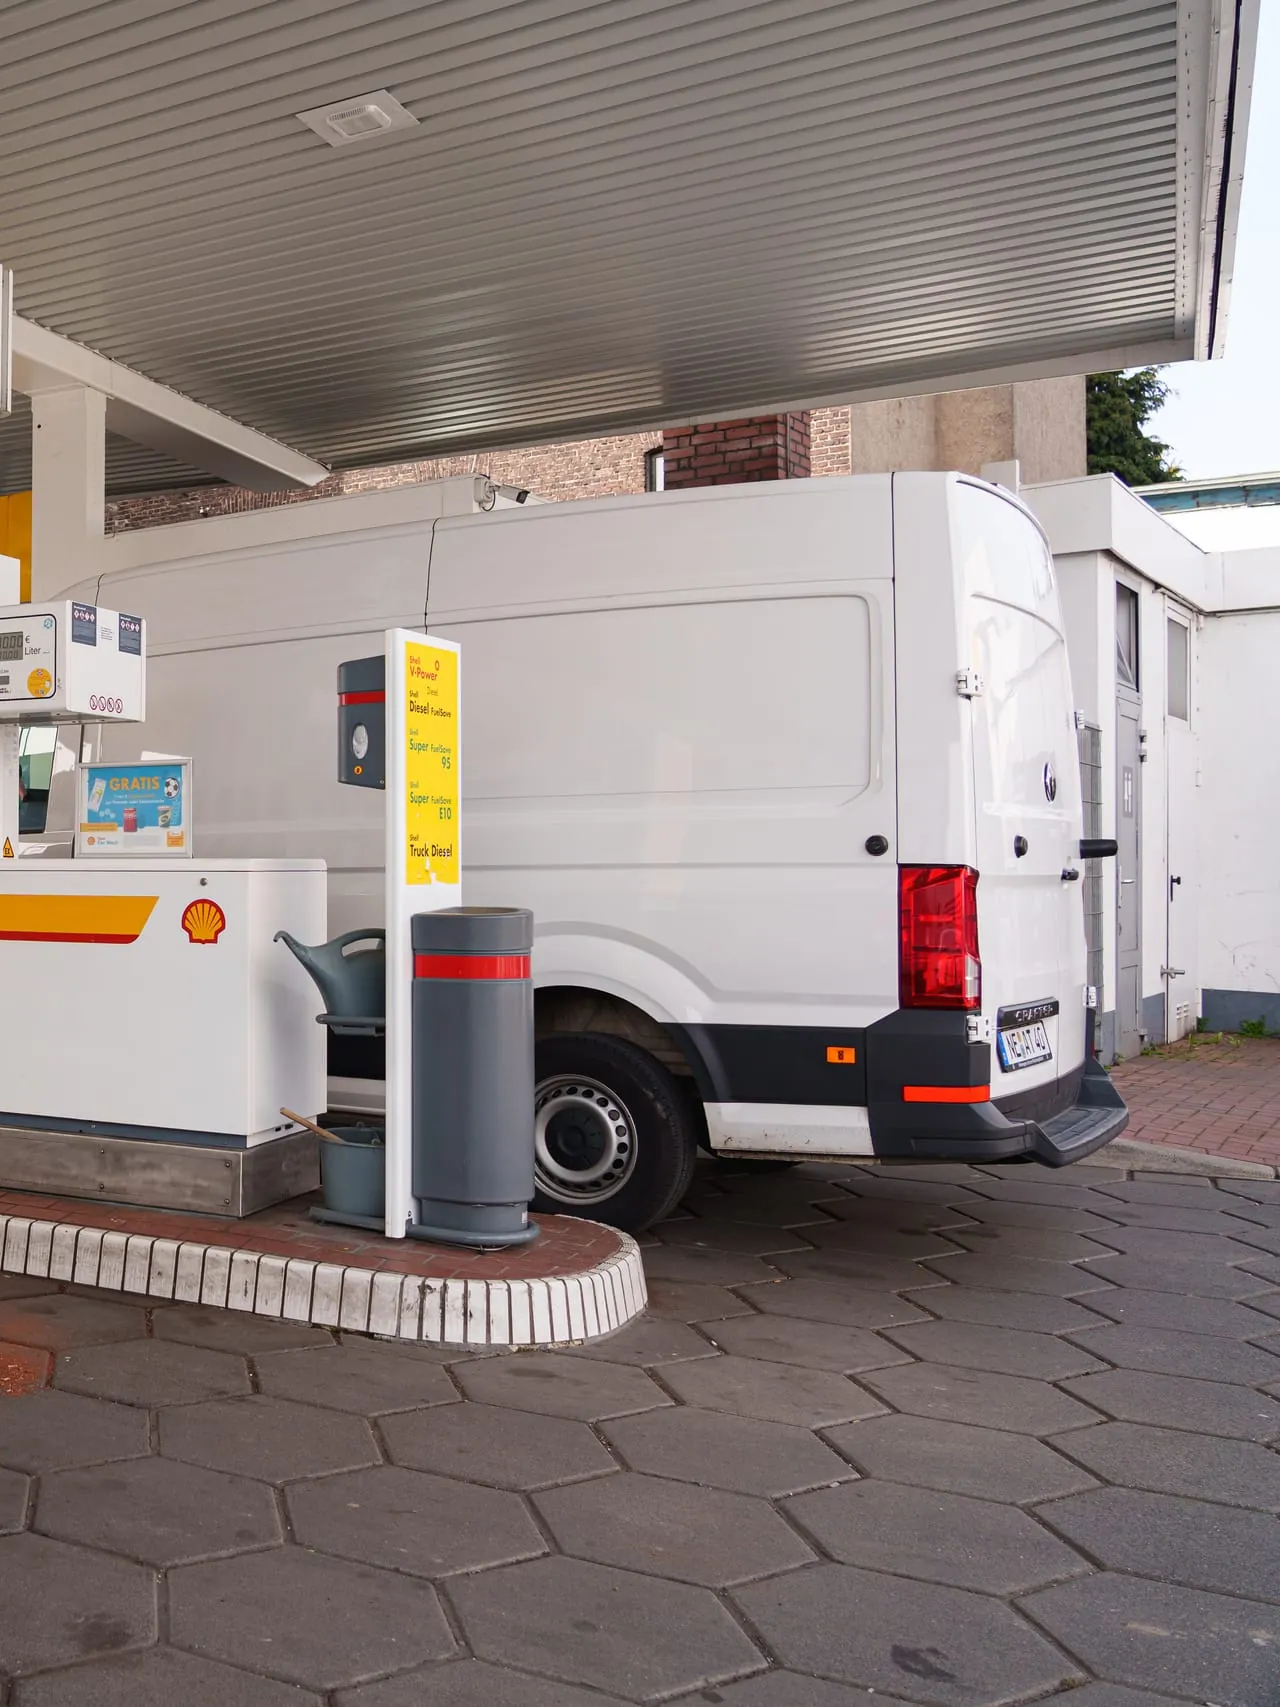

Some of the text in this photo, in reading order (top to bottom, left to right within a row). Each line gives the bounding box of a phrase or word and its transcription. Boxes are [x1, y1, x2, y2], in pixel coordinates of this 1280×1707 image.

[24, 647, 41, 656] Liter
[409, 656, 421, 665] Shell
[410, 666, 438, 681] V-Power
[409, 690, 419, 698] Shell
[409, 699, 452, 718] Diesel FuelSave
[409, 738, 452, 755] Super FuelSave
[441, 756, 451, 770] 95
[109, 776, 160, 791] GRATIS
[409, 791, 452, 807] Super FuelSave
[439, 807, 452, 820] E10
[409, 834, 419, 842] Shell
[409, 843, 453, 857] Truck Diesel
[1005, 1033, 1022, 1060] NE
